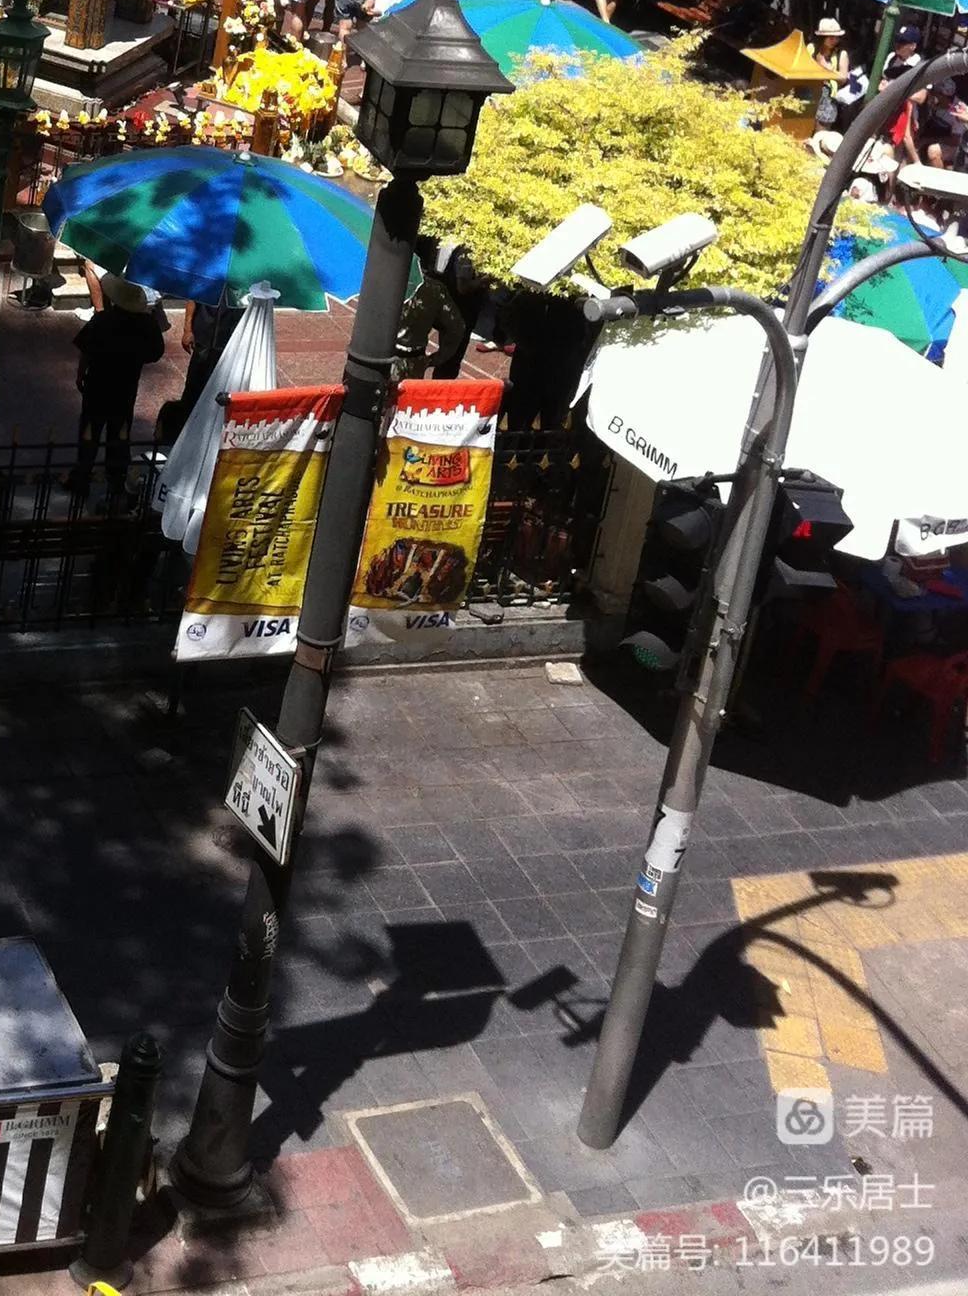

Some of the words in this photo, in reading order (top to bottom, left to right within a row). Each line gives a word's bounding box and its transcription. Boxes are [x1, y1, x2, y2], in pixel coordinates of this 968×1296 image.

[230, 477, 260, 518] ARTS
[386, 502, 474, 519] TREASURE
[245, 489, 284, 570] FESTIVAL
[266, 572, 282, 586] AT
[241, 618, 290, 637] VISA
[405, 612, 449, 629] VISA
